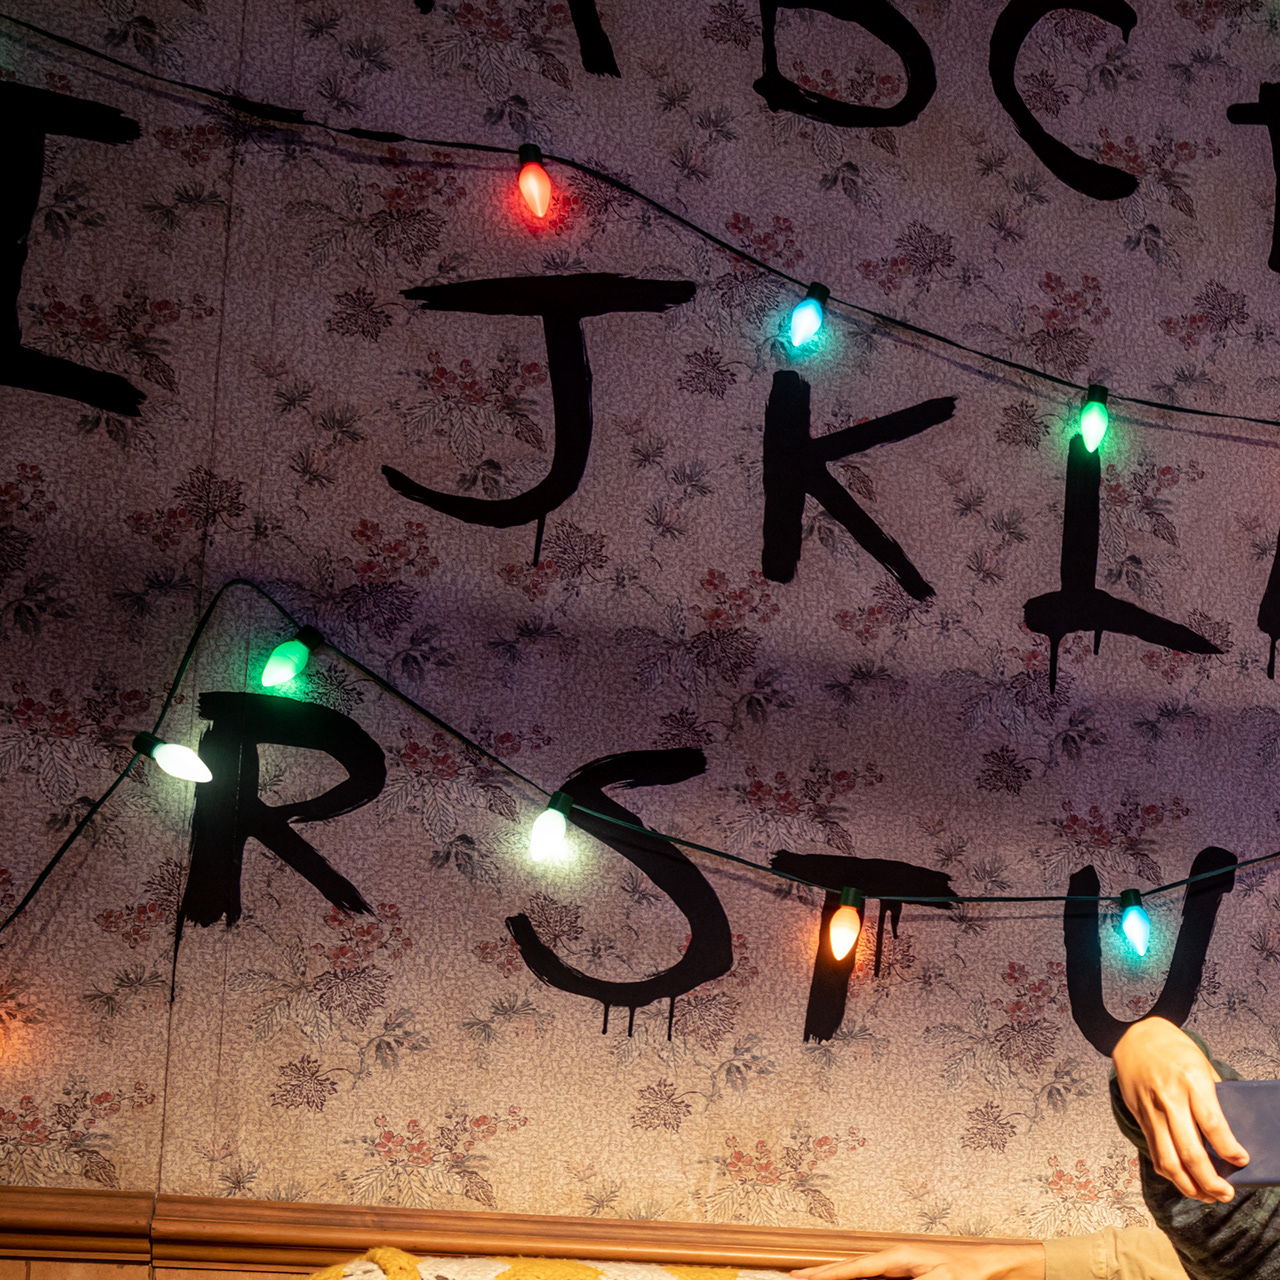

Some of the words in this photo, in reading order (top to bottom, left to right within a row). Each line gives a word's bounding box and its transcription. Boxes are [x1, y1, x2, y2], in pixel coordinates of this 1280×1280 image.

[989, 0, 1137, 200] C
[381, 272, 696, 540] J
[761, 369, 958, 601] K
[1023, 434, 1225, 680] L
[182, 690, 387, 930] R
[505, 745, 733, 1020] S
[770, 848, 962, 1044] T
[1064, 845, 1239, 1057] U
